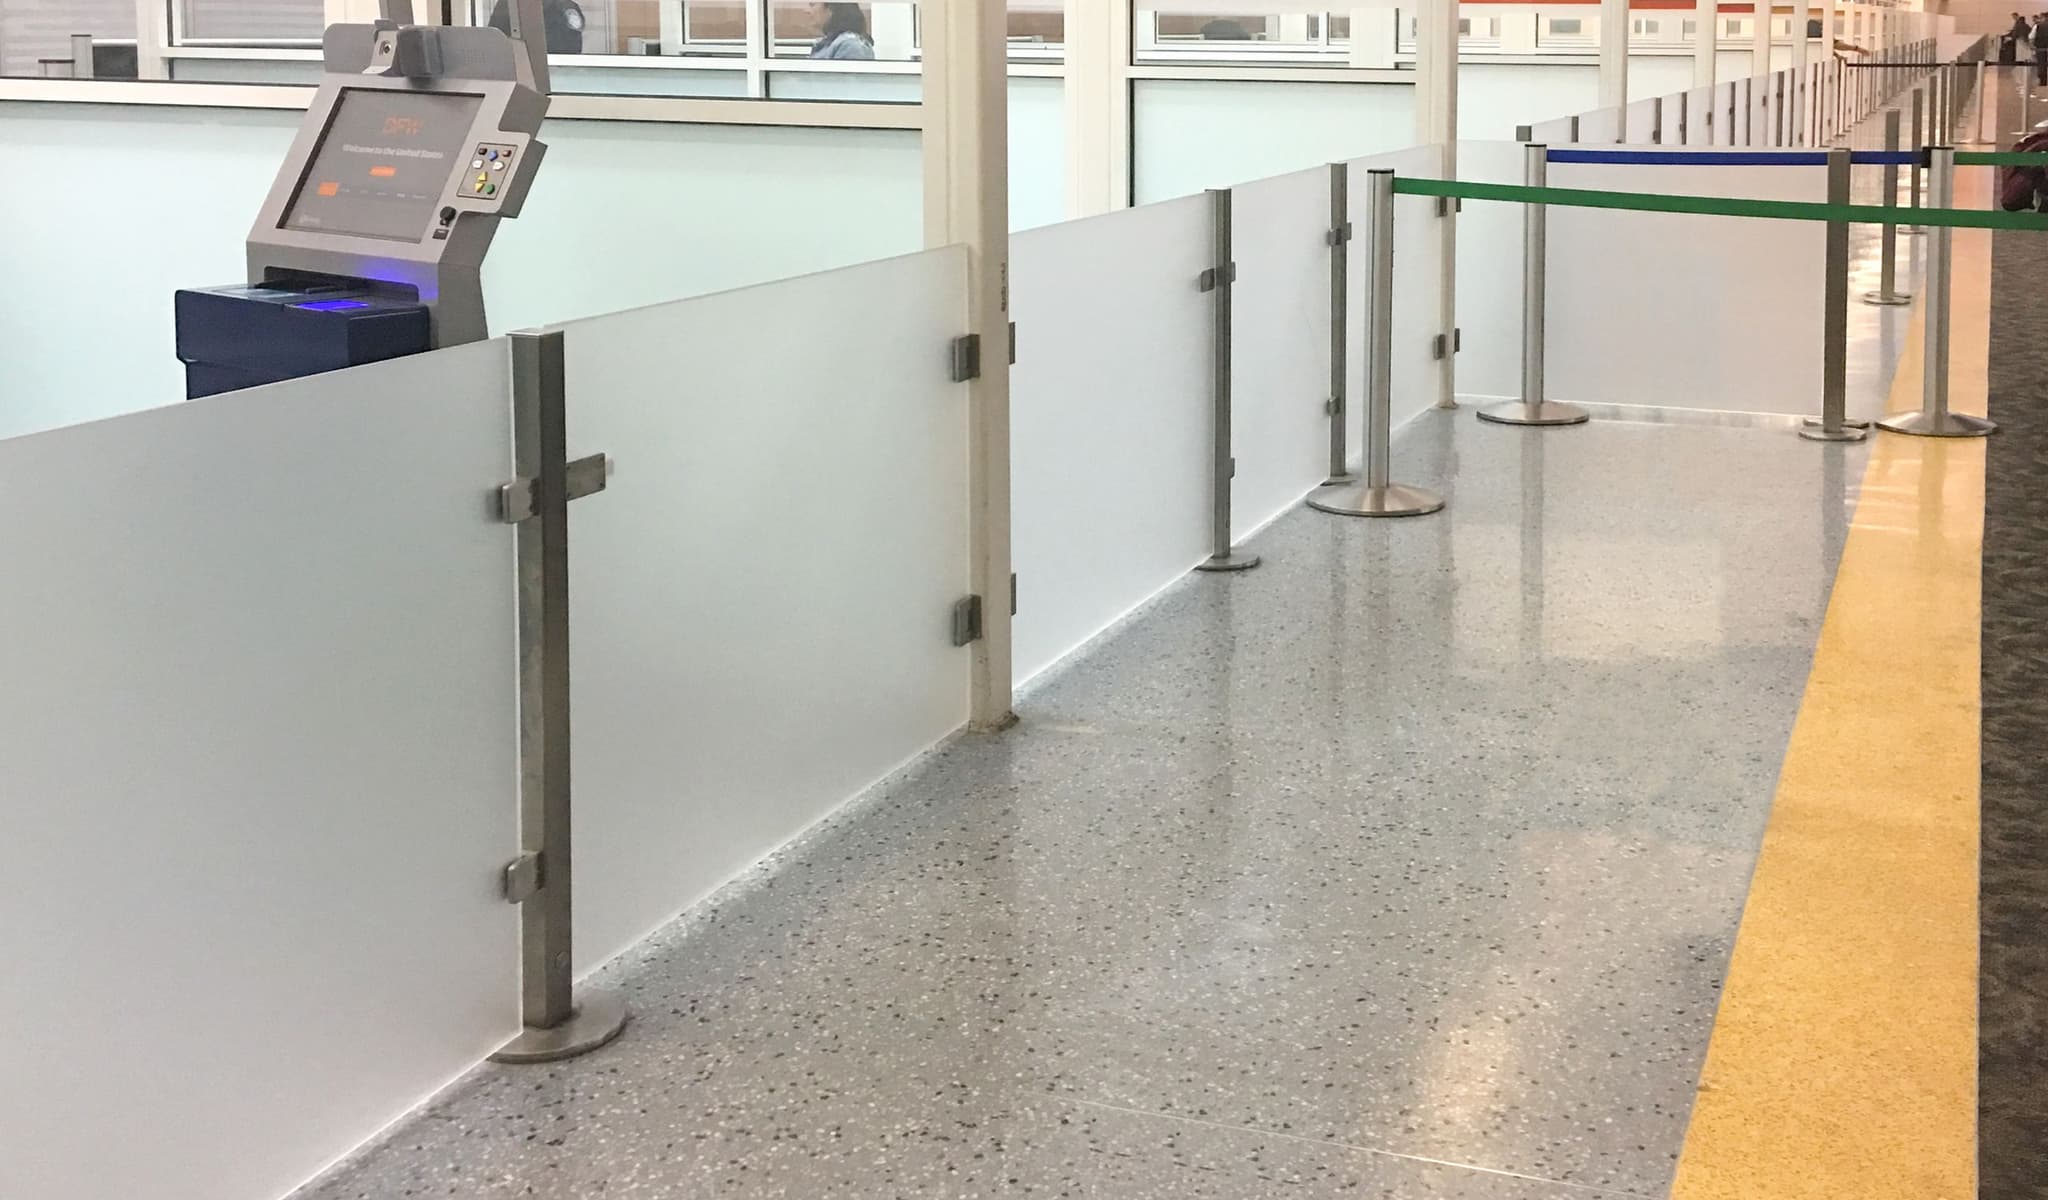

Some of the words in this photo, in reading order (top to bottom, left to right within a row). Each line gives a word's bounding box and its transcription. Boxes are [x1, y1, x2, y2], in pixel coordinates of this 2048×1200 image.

[384, 117, 424, 135] DFW
[342, 144, 373, 153] Welcome
[383, 147, 395, 156] the
[396, 148, 420, 157] United
[420, 150, 444, 159] States
